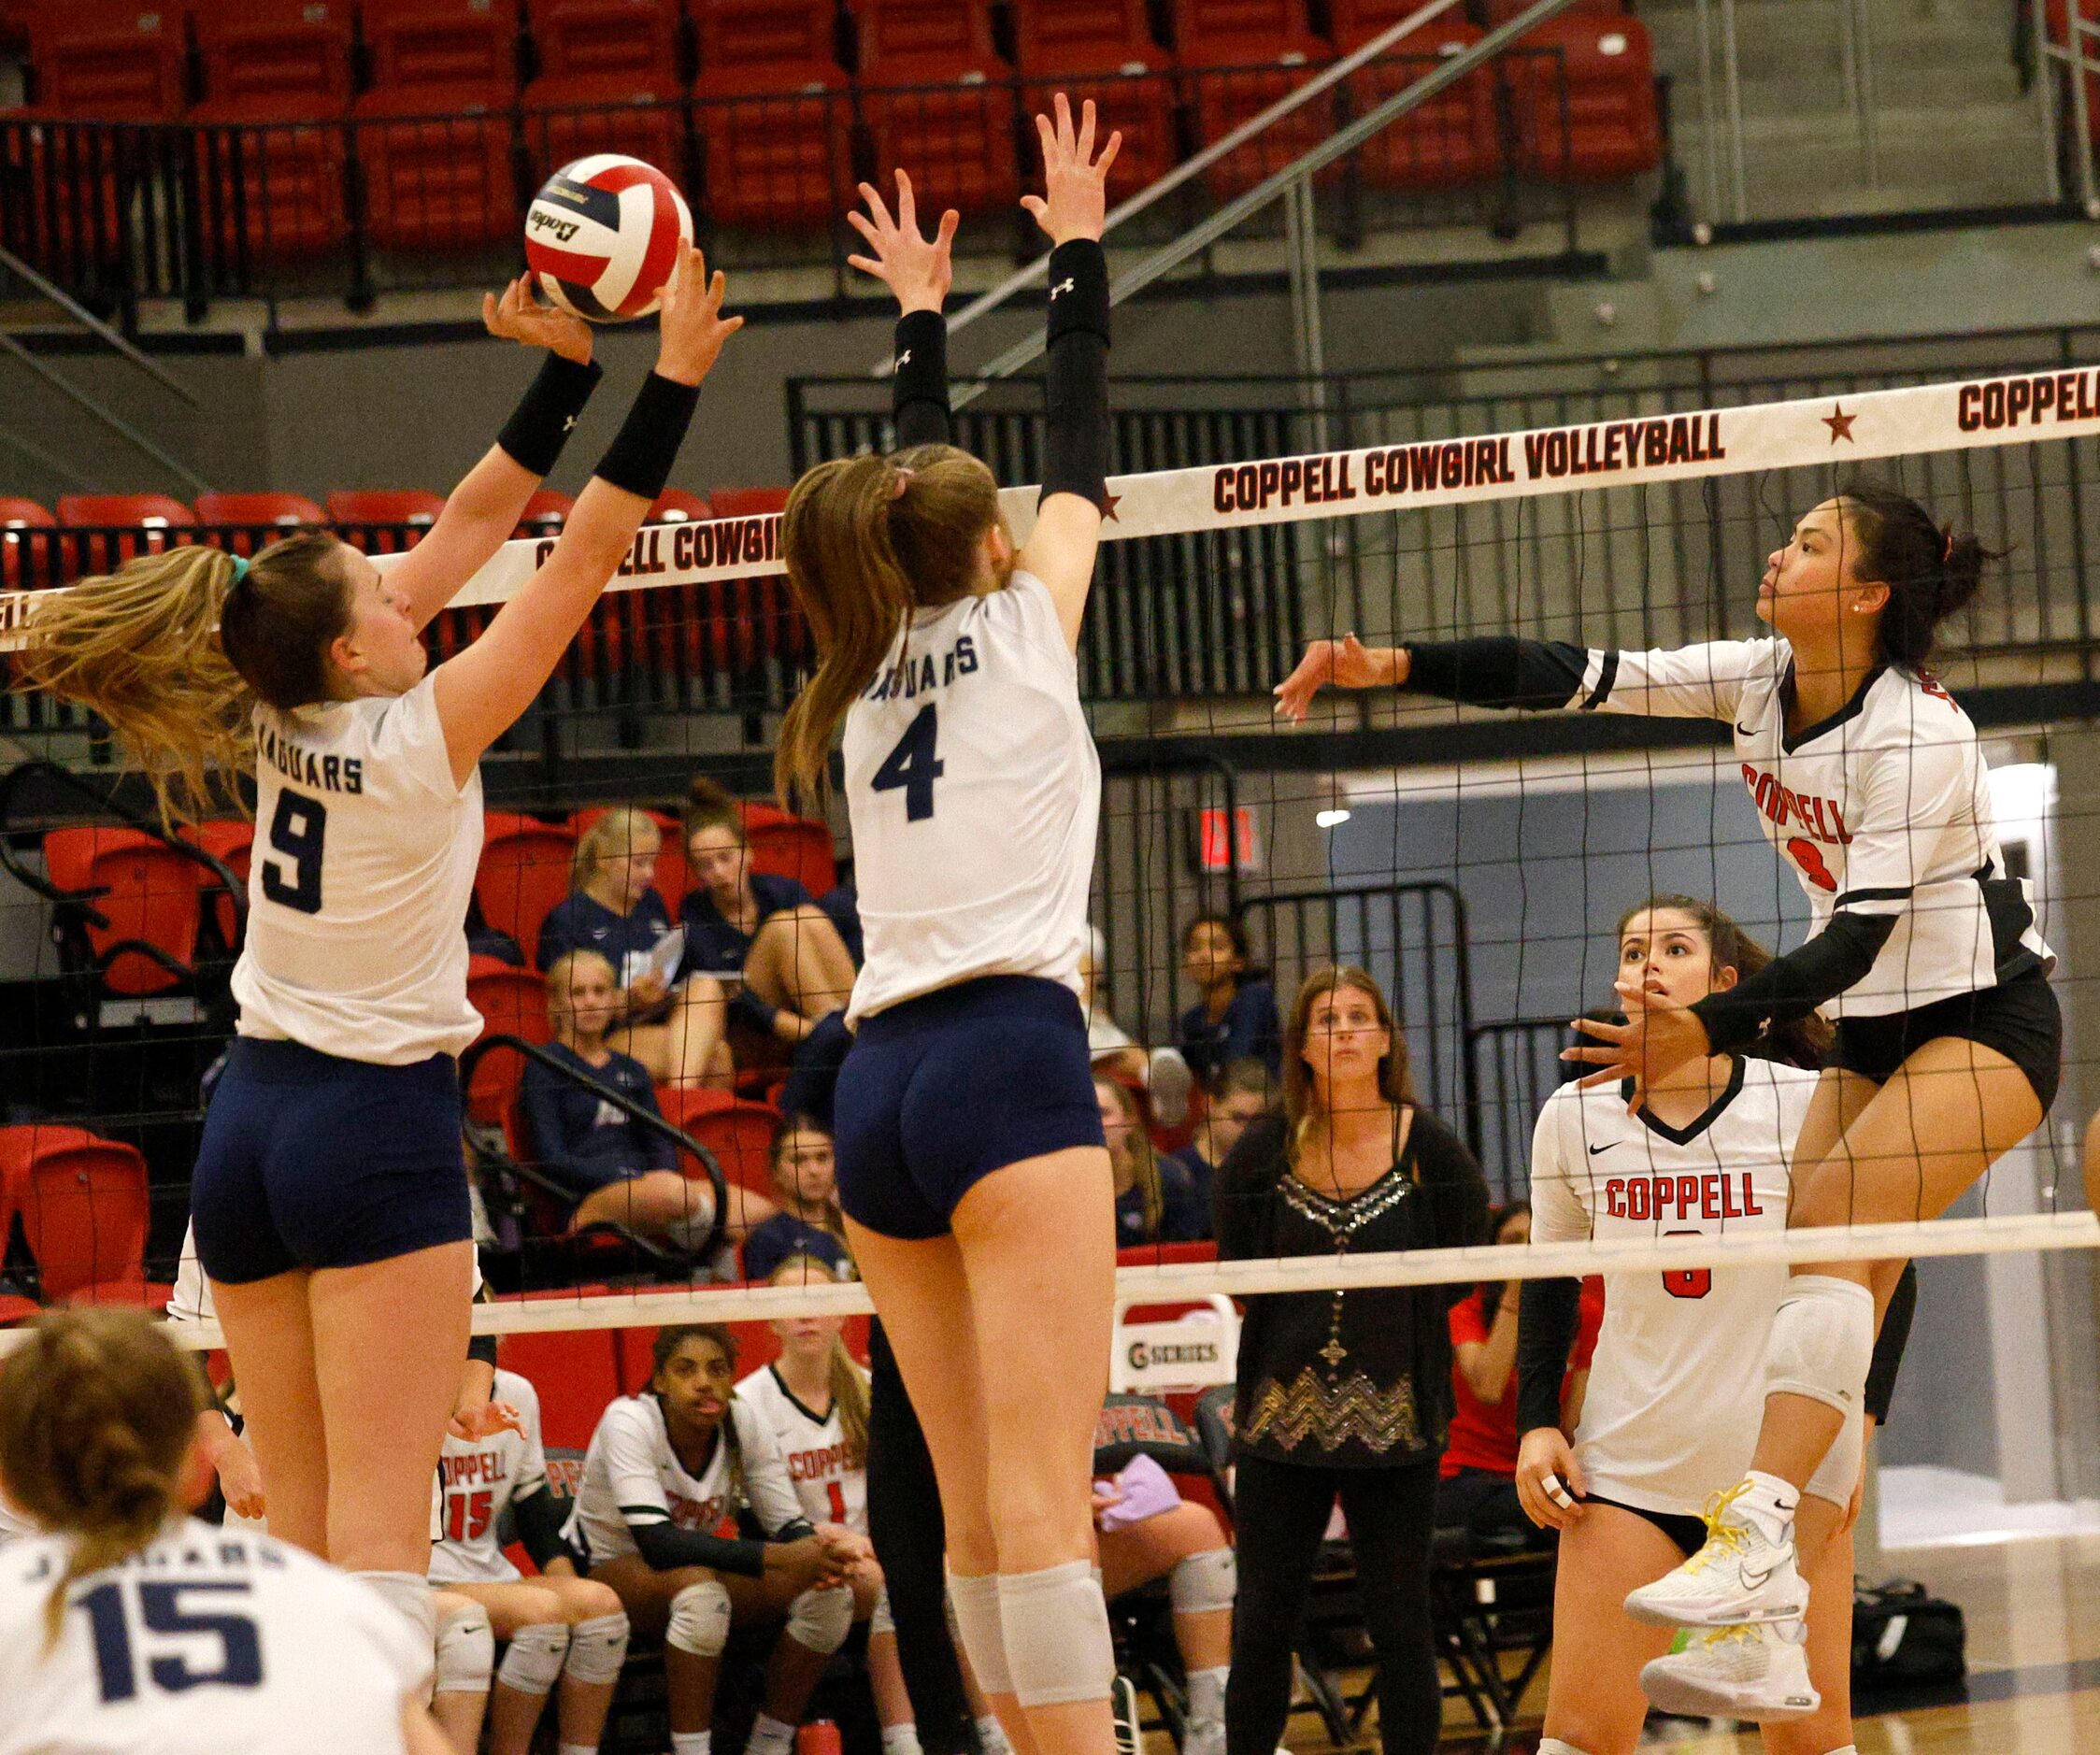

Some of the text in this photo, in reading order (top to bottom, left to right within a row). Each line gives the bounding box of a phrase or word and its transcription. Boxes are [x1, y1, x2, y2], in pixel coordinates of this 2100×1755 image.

[1214, 412, 1726, 514] COPPELL COWGIRL VOLLEYBALL
[870, 701, 944, 822] 4
[1741, 763, 1854, 845] COPPELL
[262, 787, 326, 915] 9
[1606, 1172, 1764, 1220] COPPELL
[449, 1491, 493, 1541] 15
[827, 1482, 847, 1524] 1
[69, 1582, 264, 1704] 15
